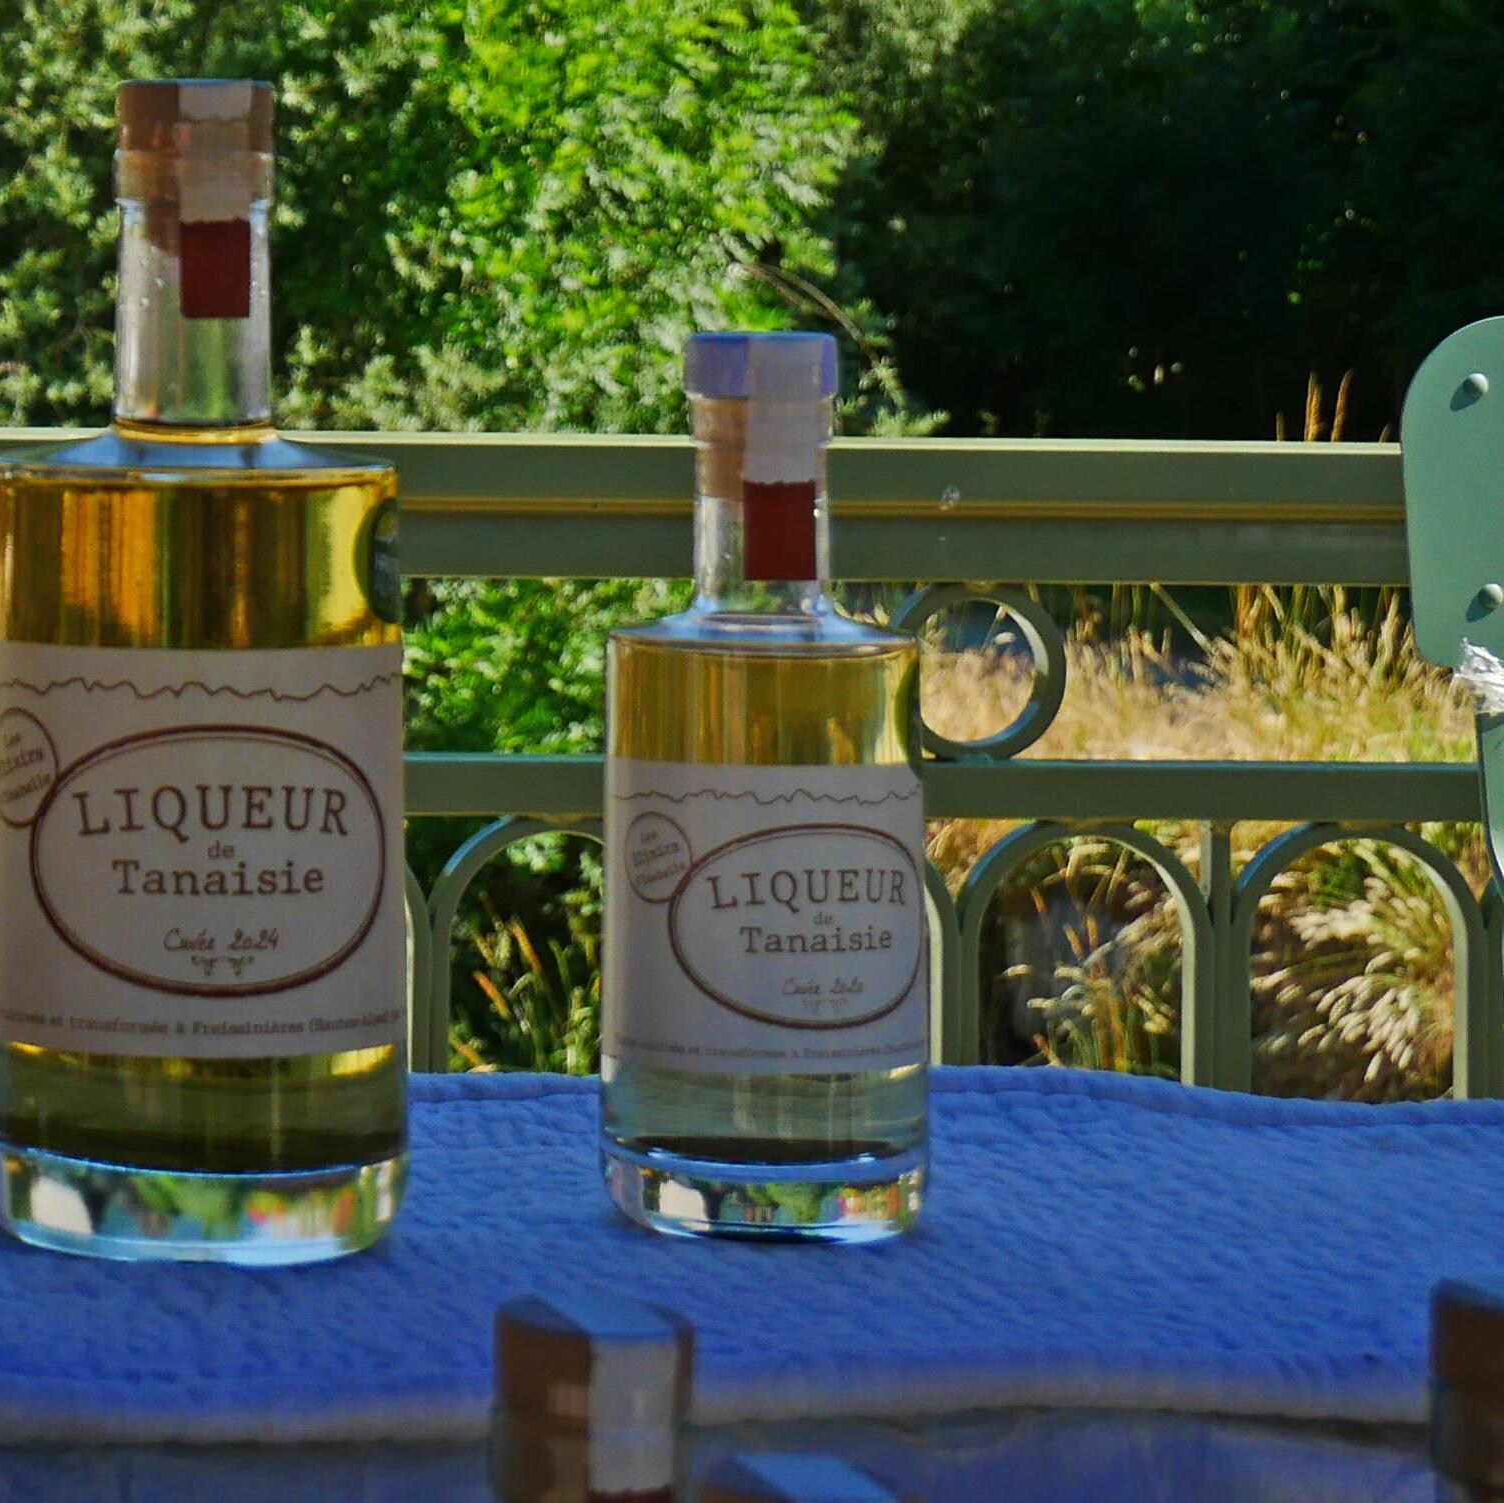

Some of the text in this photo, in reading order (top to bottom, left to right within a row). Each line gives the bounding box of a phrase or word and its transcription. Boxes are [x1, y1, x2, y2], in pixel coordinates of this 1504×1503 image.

[72, 784, 347, 843] LIQUEUR
[207, 841, 235, 859] de
[112, 859, 323, 896] Tanaisie
[706, 868, 905, 914] LIQUEUR
[813, 912, 833, 926] de
[740, 926, 891, 953] Tanaisie
